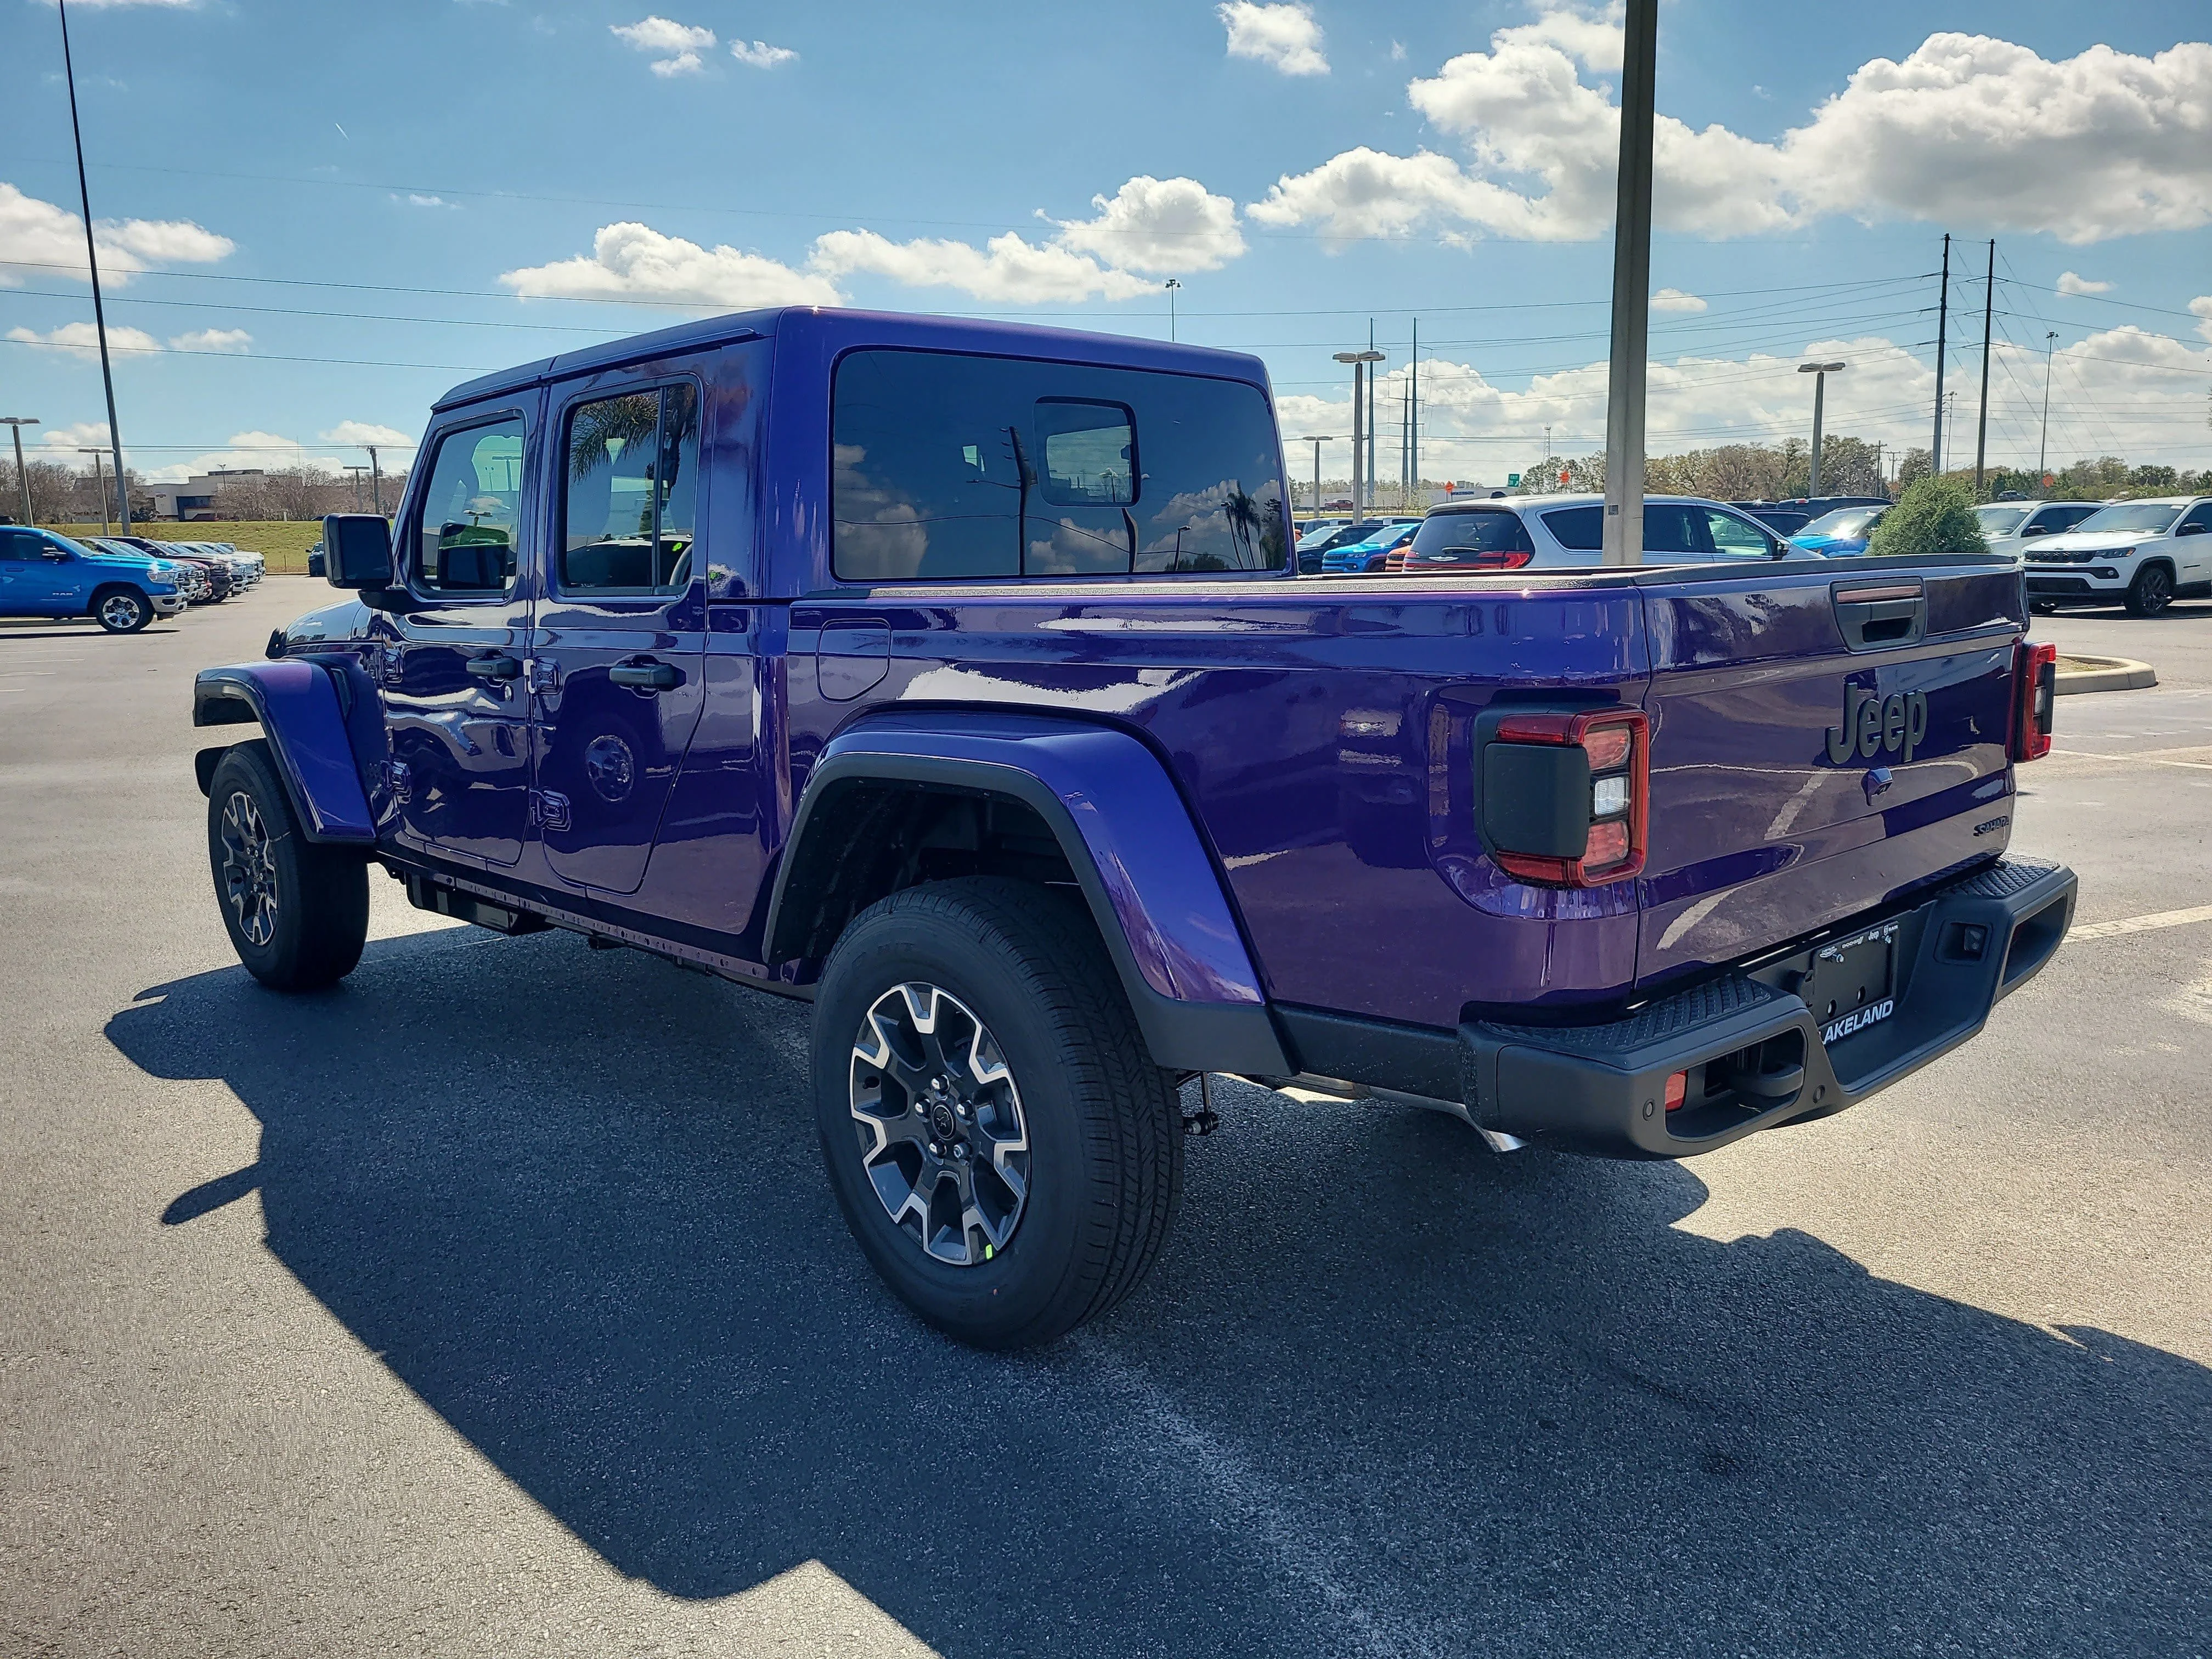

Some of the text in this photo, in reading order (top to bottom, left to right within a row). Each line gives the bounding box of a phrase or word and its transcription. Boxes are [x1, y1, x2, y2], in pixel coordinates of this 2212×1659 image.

[1825, 681, 1927, 765] Jeep
[1973, 815, 2010, 837] SAHARA
[1868, 930, 1879, 941] Jeep
[1819, 1000, 1893, 1045] AKELAND
